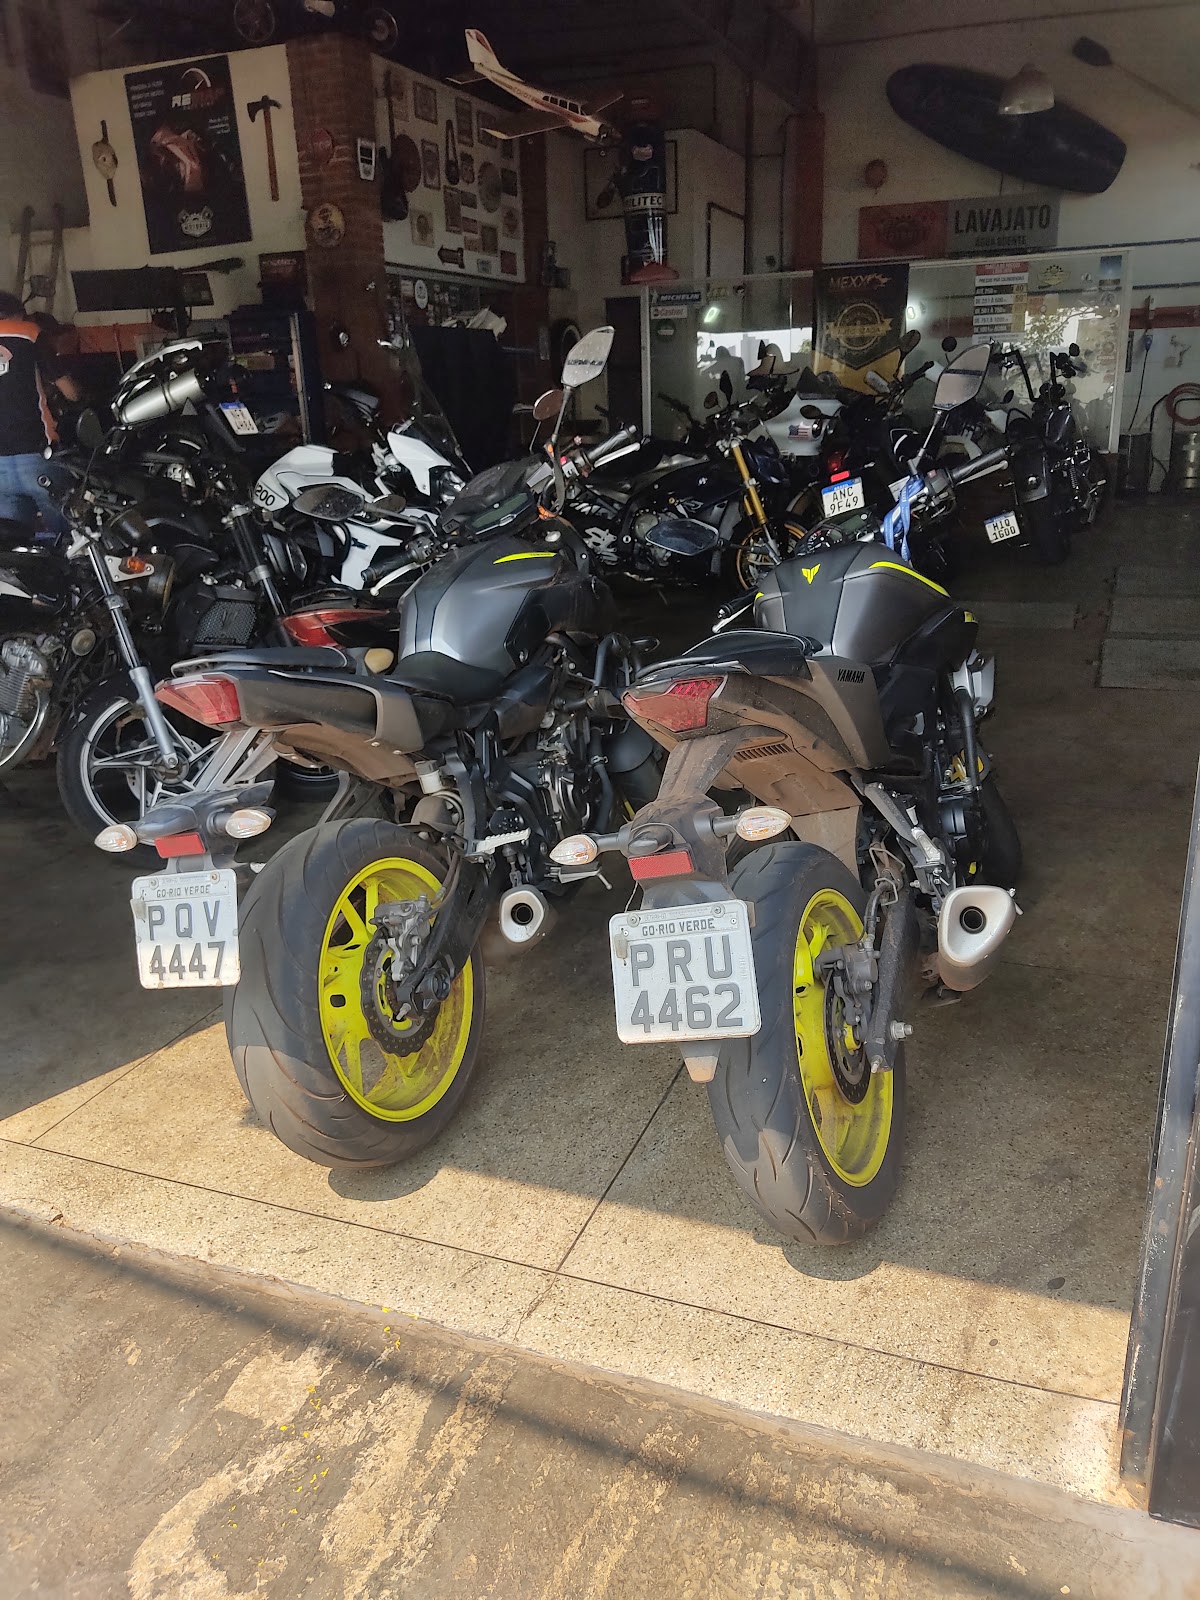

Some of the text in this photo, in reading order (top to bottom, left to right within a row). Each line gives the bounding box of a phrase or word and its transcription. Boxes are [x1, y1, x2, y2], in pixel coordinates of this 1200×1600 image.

[624, 196, 662, 208] LITEC
[954, 204, 1051, 234] LAVAJATO
[660, 293, 701, 301] MICHELIN
[660, 308, 684, 317] Castrol
[255, 483, 275, 506] 200
[832, 486, 854, 502] ANC
[829, 495, 859, 514] 9F49
[992, 526, 1016, 540] 1600
[837, 668, 866, 684] YAMAHA
[184, 884, 211, 895] VERDE
[148, 900, 220, 941] PQV
[678, 918, 716, 932] VERDE
[149, 940, 226, 981] 4447
[630, 934, 733, 987] PRU
[630, 981, 743, 1034] 4462
